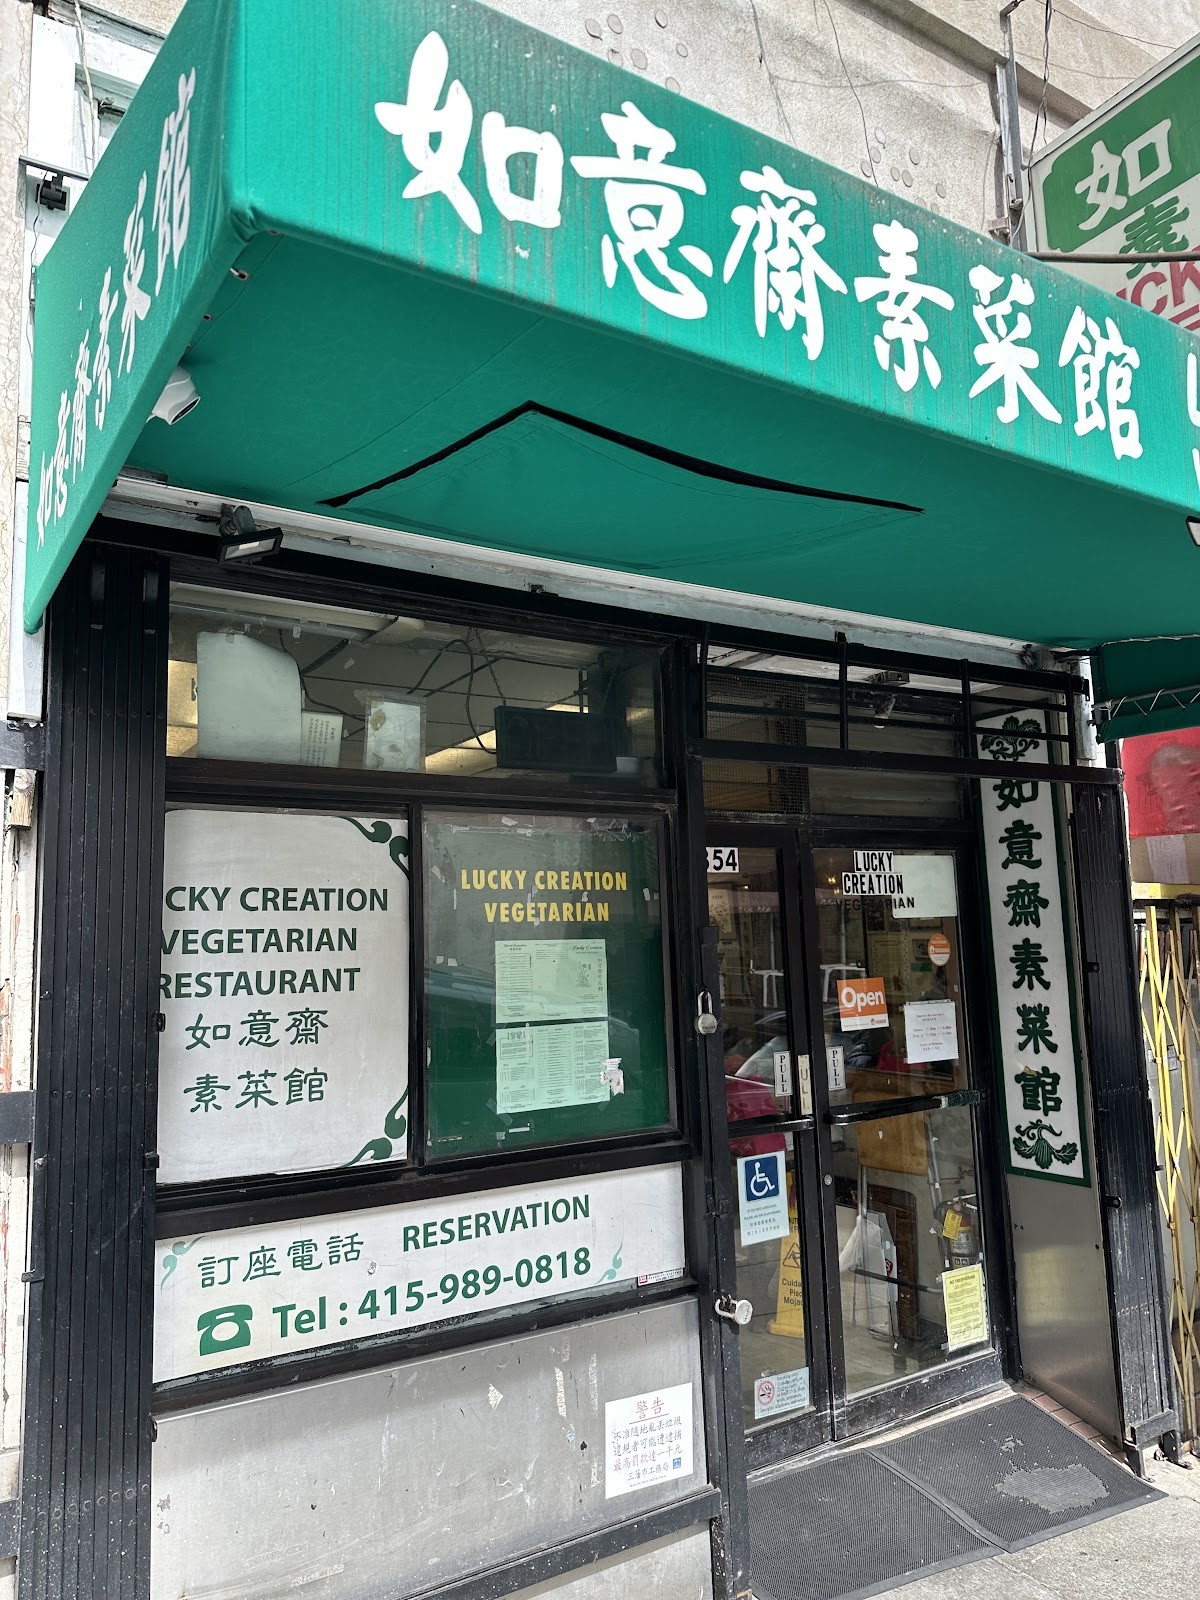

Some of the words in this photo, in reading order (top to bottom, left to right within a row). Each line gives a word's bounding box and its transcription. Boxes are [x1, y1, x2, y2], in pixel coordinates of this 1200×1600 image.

[374, 30, 1143, 460] 如意齋素菜館
[854, 852, 893, 872] LUCKY
[461, 869, 527, 890] LUCKY
[534, 870, 627, 891] CREATION
[843, 873, 904, 894] CREATION
[240, 887, 388, 912] CREATION
[484, 902, 609, 923] VEGETARIAN
[836, 897, 915, 911] VEGETARIAN
[161, 927, 357, 955] VEGETARIAN
[993, 778, 1063, 1117] 如意齋素菜館
[159, 967, 361, 999] RESTAURANT
[841, 986, 884, 1012] Open
[184, 1007, 329, 1050] 如意齋
[779, 1055, 788, 1093] PULL
[832, 1050, 841, 1086] PULL
[183, 1066, 328, 1113] 素菜館
[198, 1232, 364, 1288] 訂座電話
[403, 1194, 590, 1252] RESERVATION
[357, 1246, 591, 1320] 415-989-0818
[635, 1396, 665, 1420] 警告
